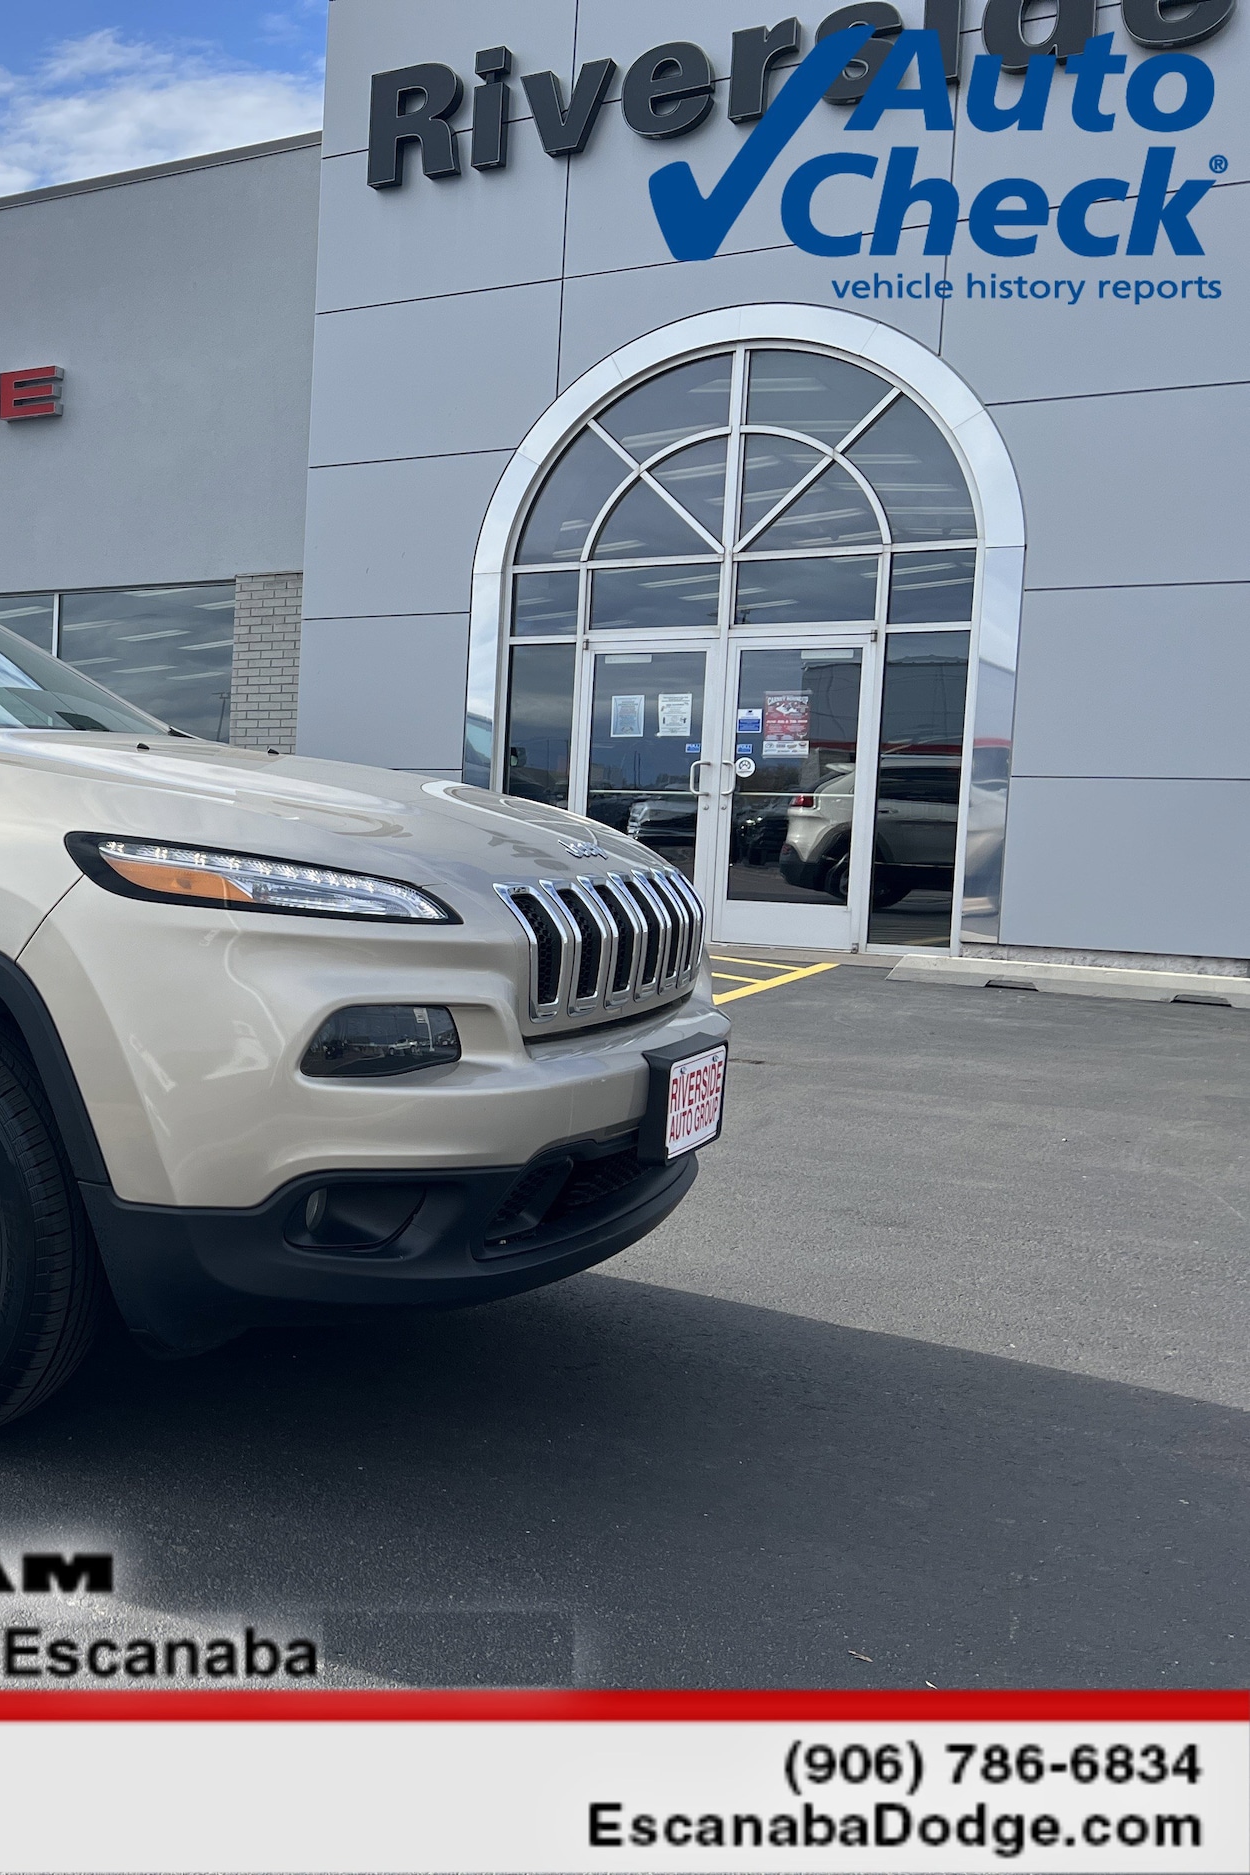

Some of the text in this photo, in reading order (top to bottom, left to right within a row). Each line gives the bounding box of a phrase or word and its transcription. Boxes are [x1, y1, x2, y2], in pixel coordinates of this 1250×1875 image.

[670, 1061, 723, 1114] RIVERSIDE
[669, 1096, 719, 1143] AUTO GROUP
